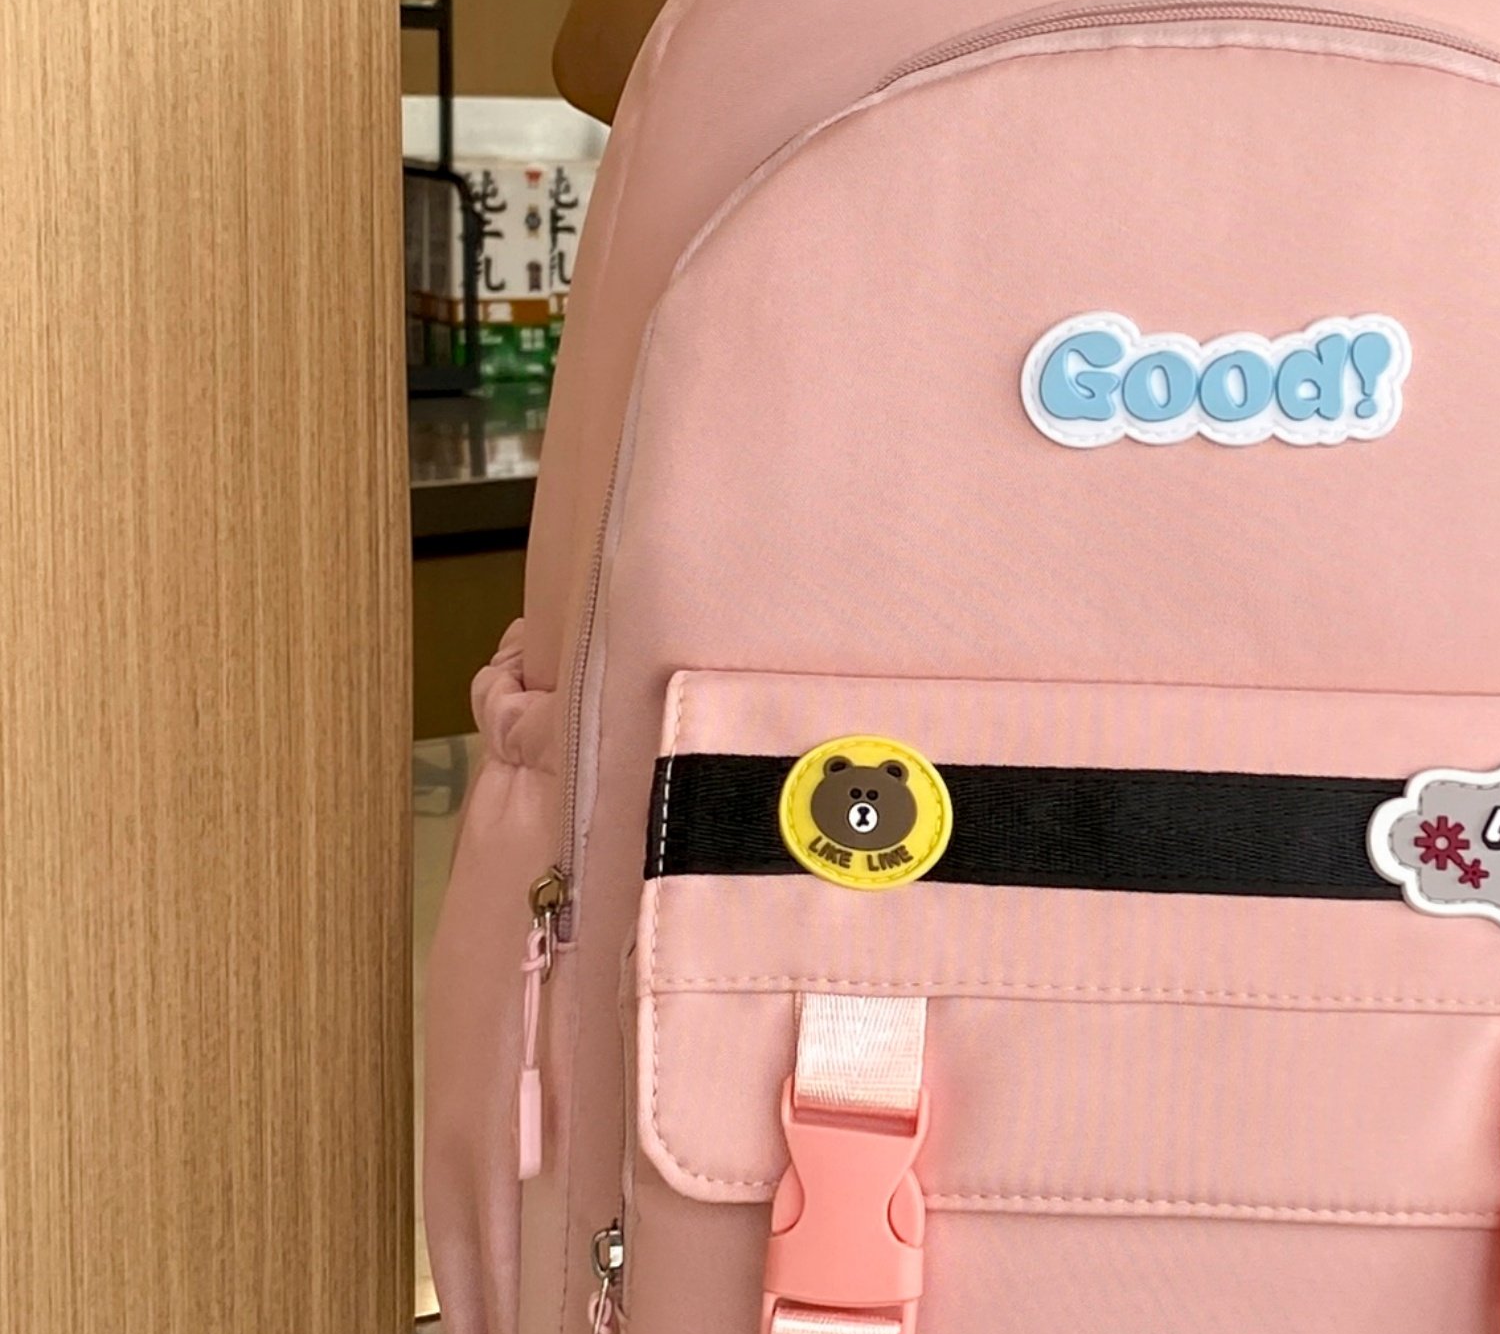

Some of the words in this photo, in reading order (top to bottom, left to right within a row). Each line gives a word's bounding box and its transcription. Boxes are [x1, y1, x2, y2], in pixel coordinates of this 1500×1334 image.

[1039, 330, 1392, 423] Good!
[808, 835, 853, 869] LIKE
[866, 844, 914, 872] LINE
